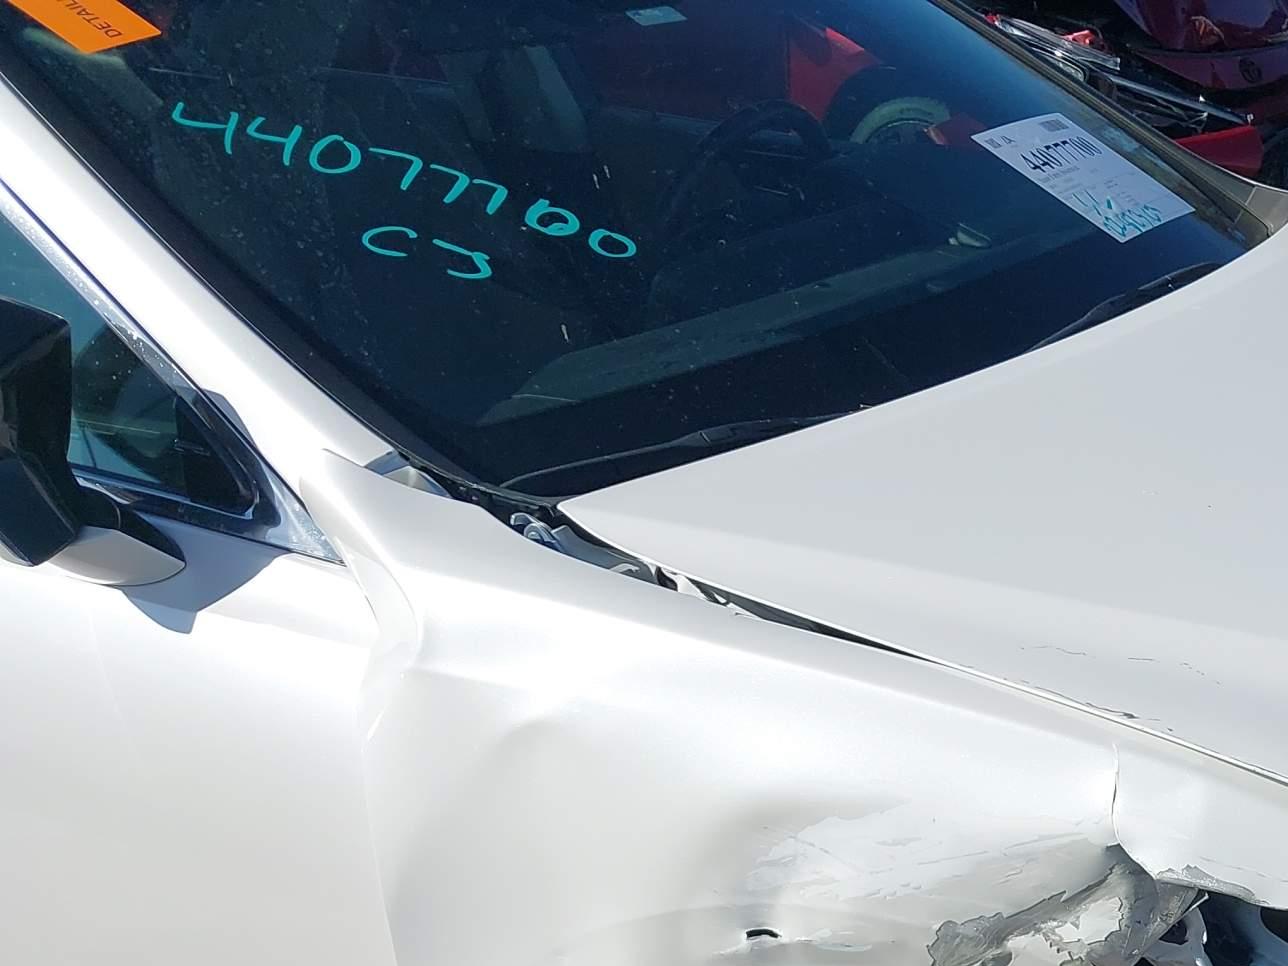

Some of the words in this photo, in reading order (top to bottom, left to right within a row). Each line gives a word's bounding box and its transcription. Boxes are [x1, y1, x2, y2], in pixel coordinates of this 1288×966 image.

[56, 0, 122, 38] DETAIL
[1020, 136, 1103, 173] 44077700
[172, 101, 637, 258] 44077700
